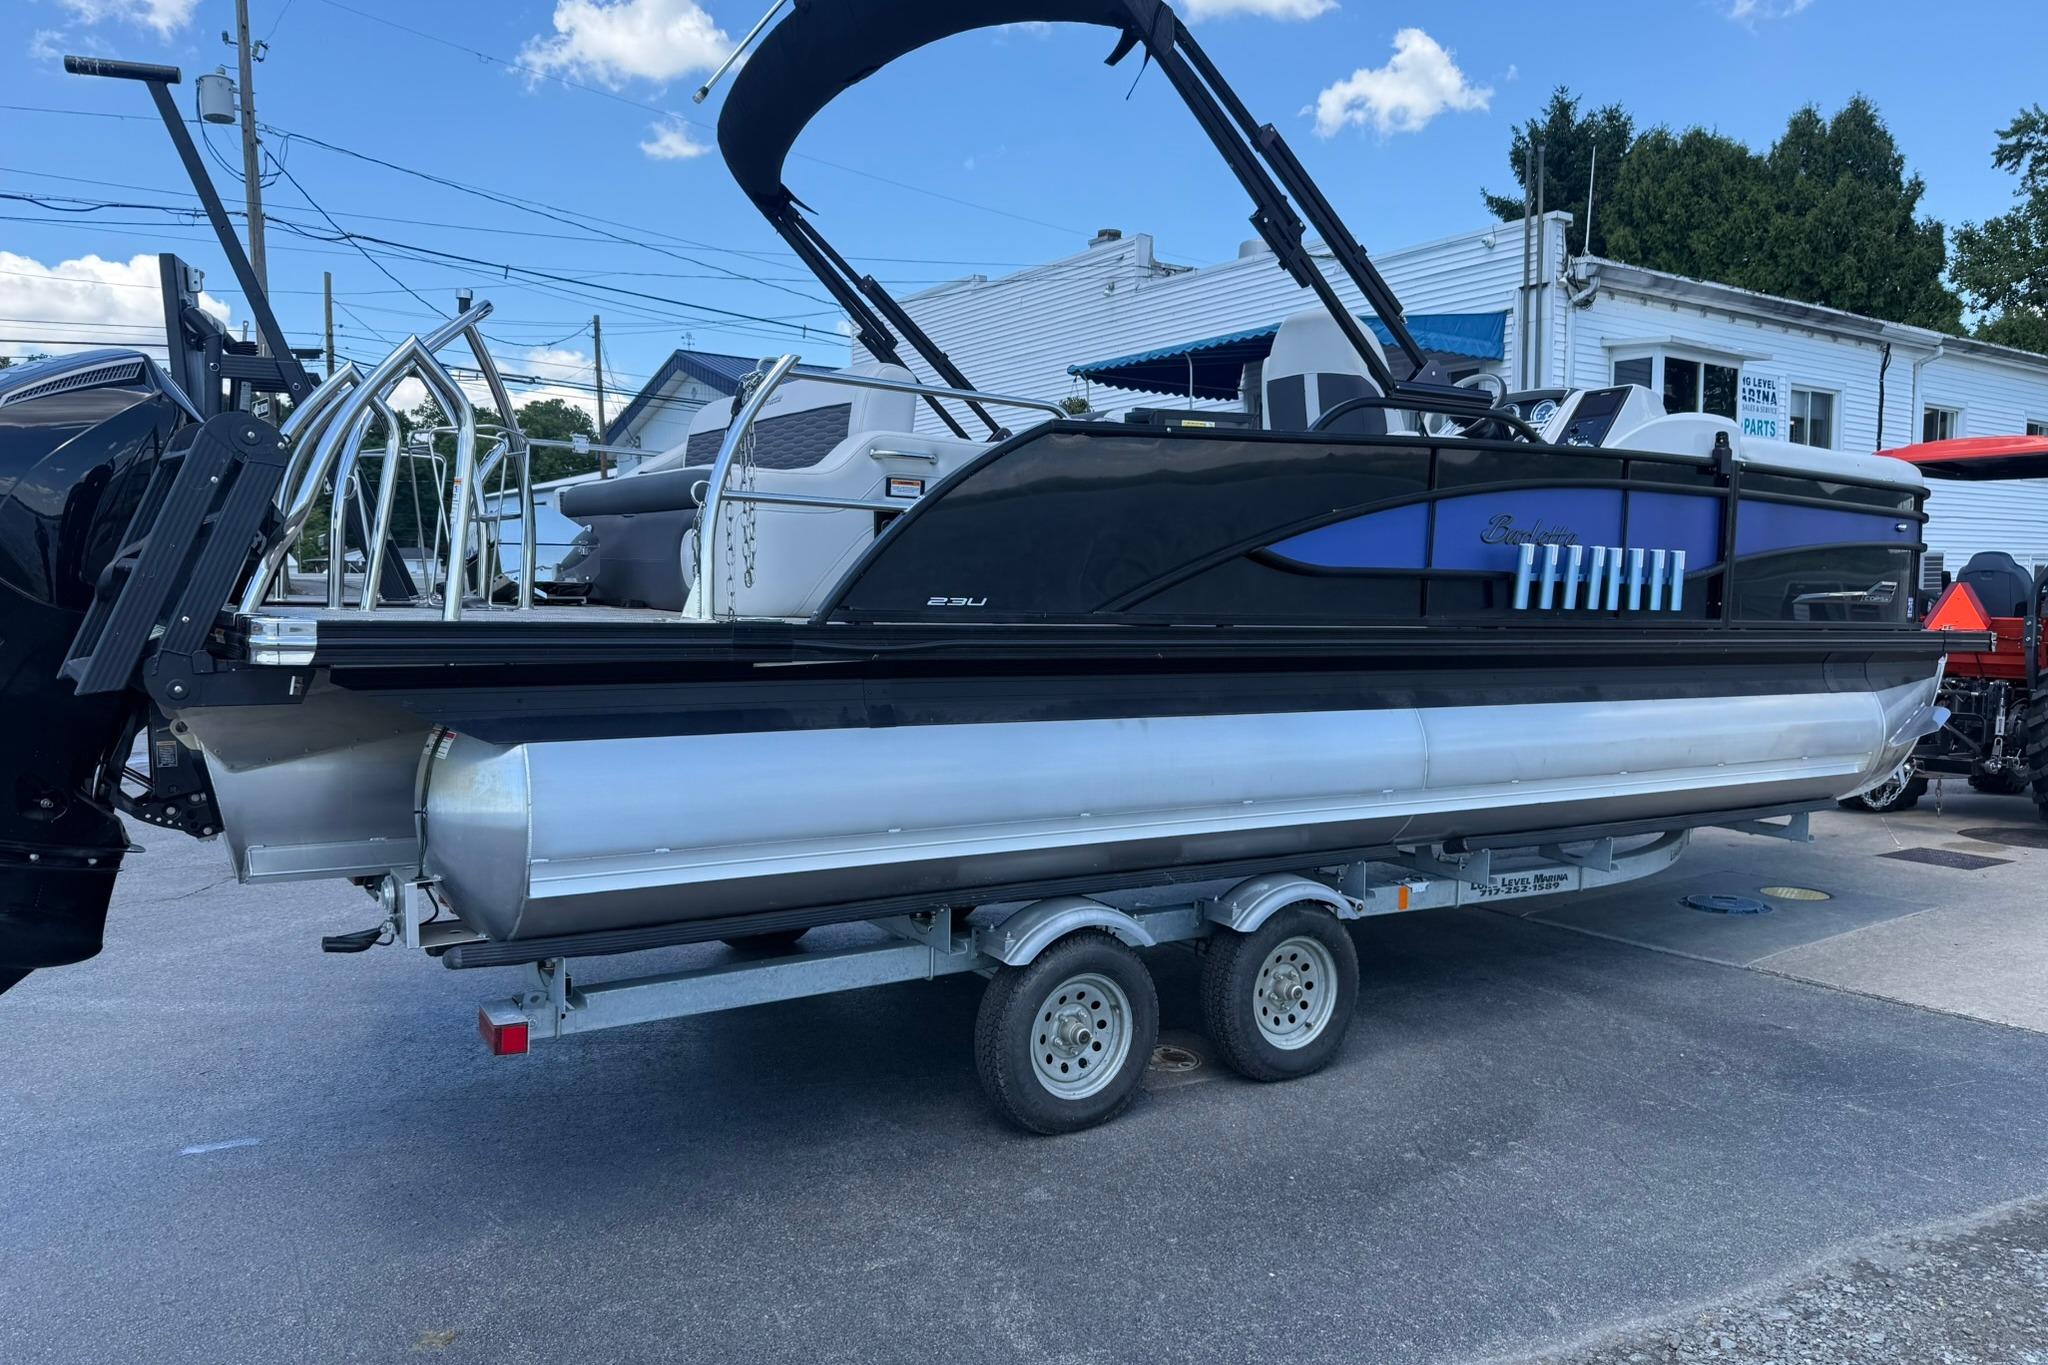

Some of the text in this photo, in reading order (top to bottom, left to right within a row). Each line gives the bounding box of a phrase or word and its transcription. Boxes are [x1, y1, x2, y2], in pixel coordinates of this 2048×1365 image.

[1753, 377, 1776, 390] LEVEL
[1744, 418, 1776, 437] PARTS
[1480, 513, 1578, 547] Barletta
[927, 597, 987, 606] 23U
[1480, 882, 1559, 897] 717-252-1589
[1501, 877, 1531, 888] LEVEL
